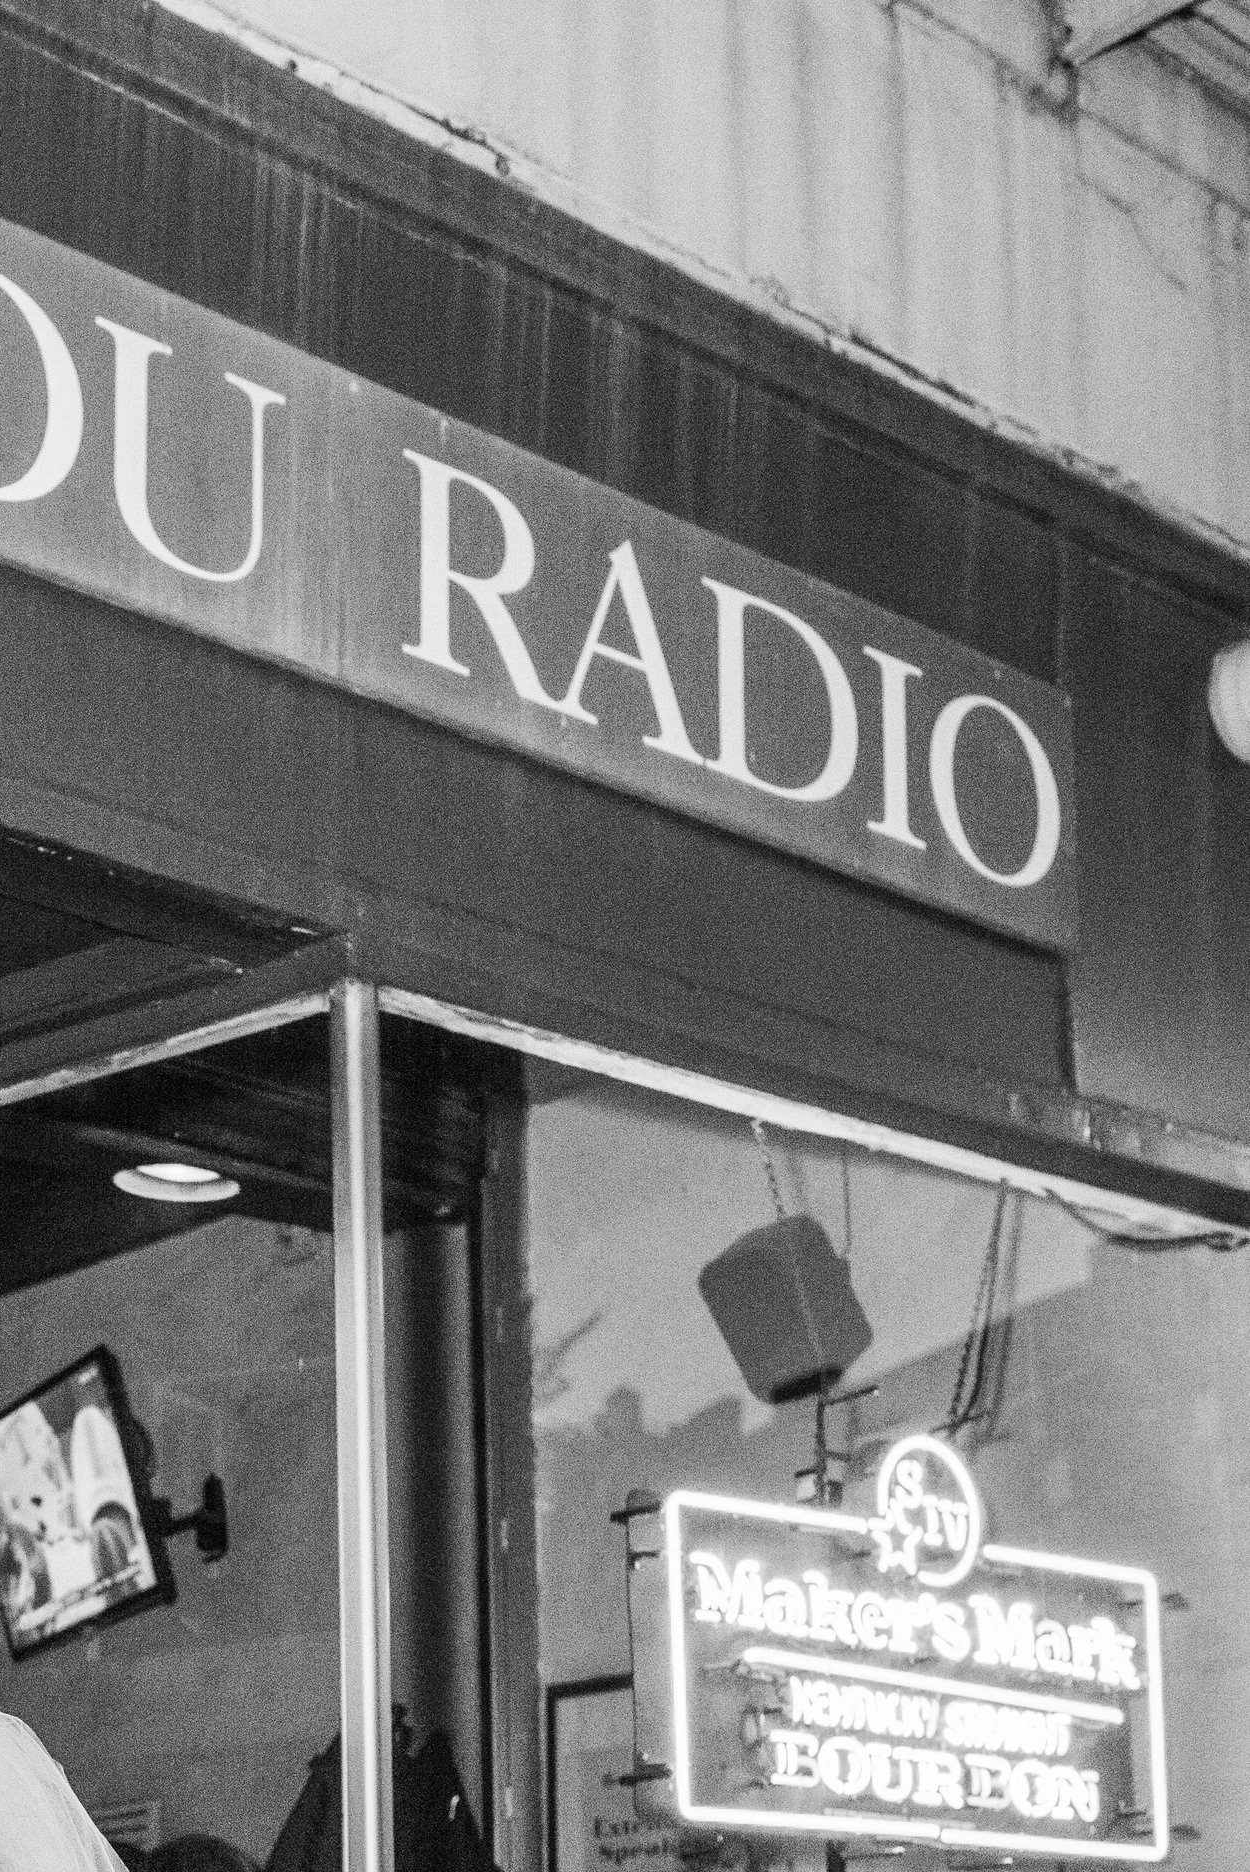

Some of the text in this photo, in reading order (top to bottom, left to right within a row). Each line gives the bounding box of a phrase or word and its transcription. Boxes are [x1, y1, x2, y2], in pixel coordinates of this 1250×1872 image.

[401, 448, 1061, 887] RADIO
[689, 1551, 1140, 1690] Maker's Mark
[770, 1730, 1099, 1822] BOURBON
